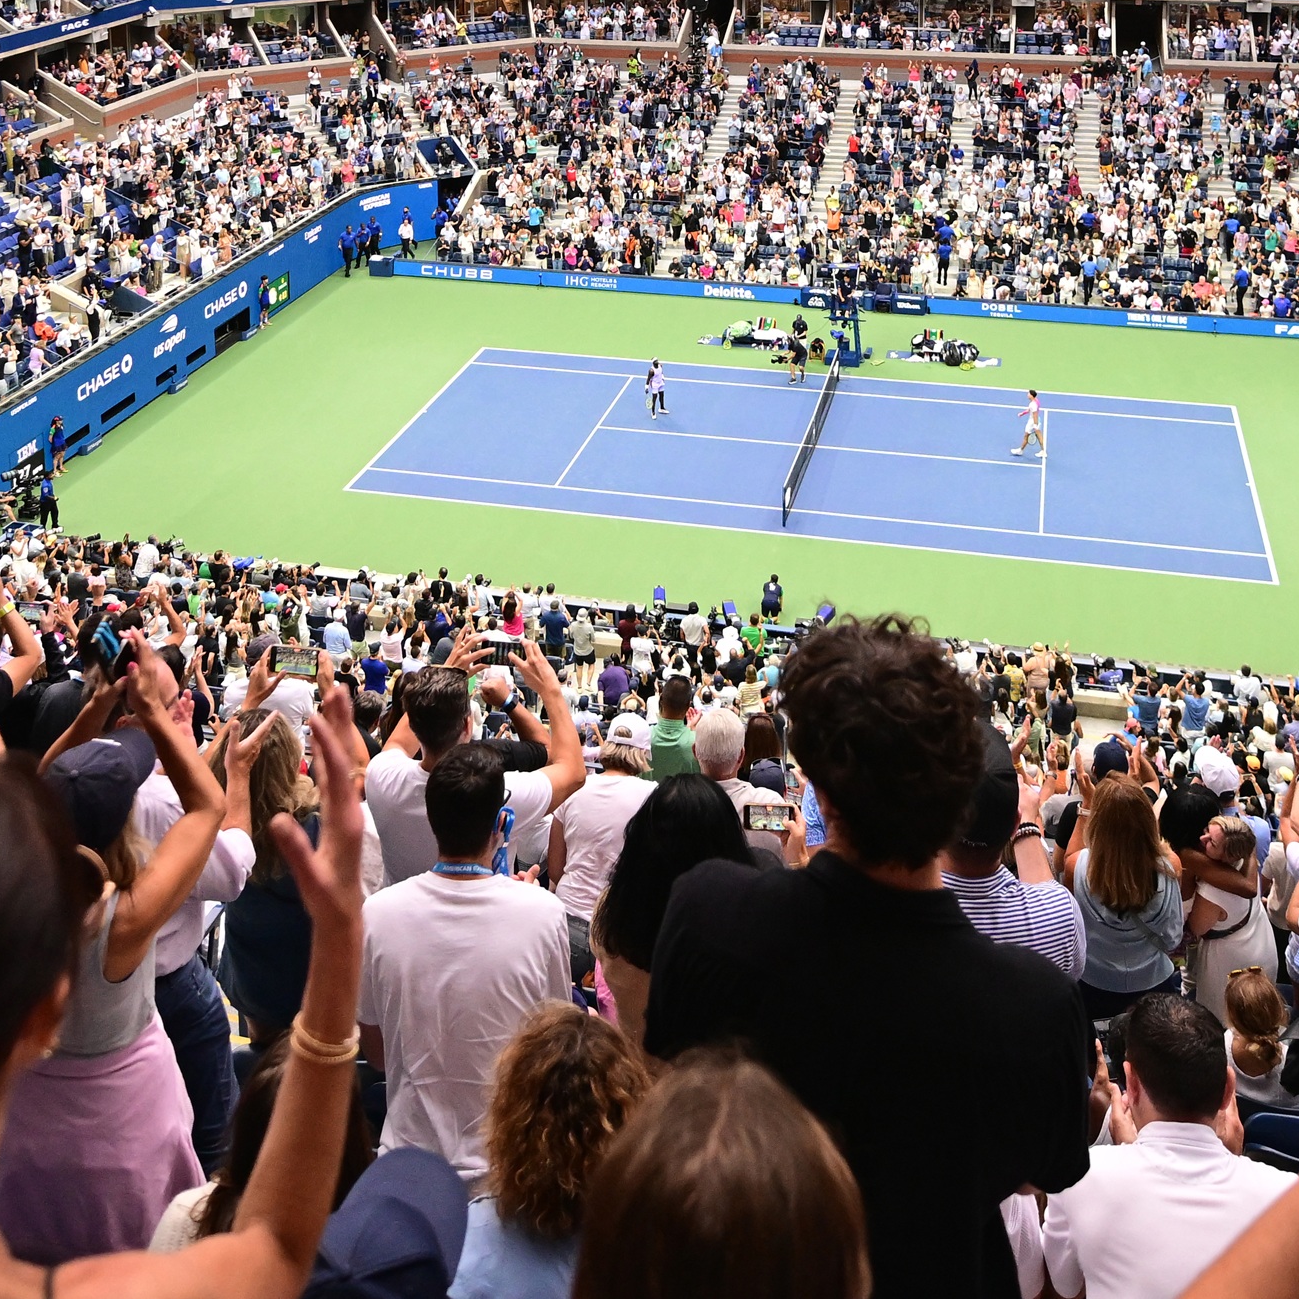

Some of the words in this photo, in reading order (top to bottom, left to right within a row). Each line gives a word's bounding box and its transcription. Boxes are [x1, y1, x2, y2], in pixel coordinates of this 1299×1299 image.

[421, 265, 493, 280] CHUBB
[565, 275, 589, 287] IHG
[703, 284, 755, 299] Deloitte.
[204, 290, 239, 319] CHASE
[981, 302, 1022, 313] DOBEL
[77, 362, 121, 401] CHASE
[16, 439, 38, 463] IBM
